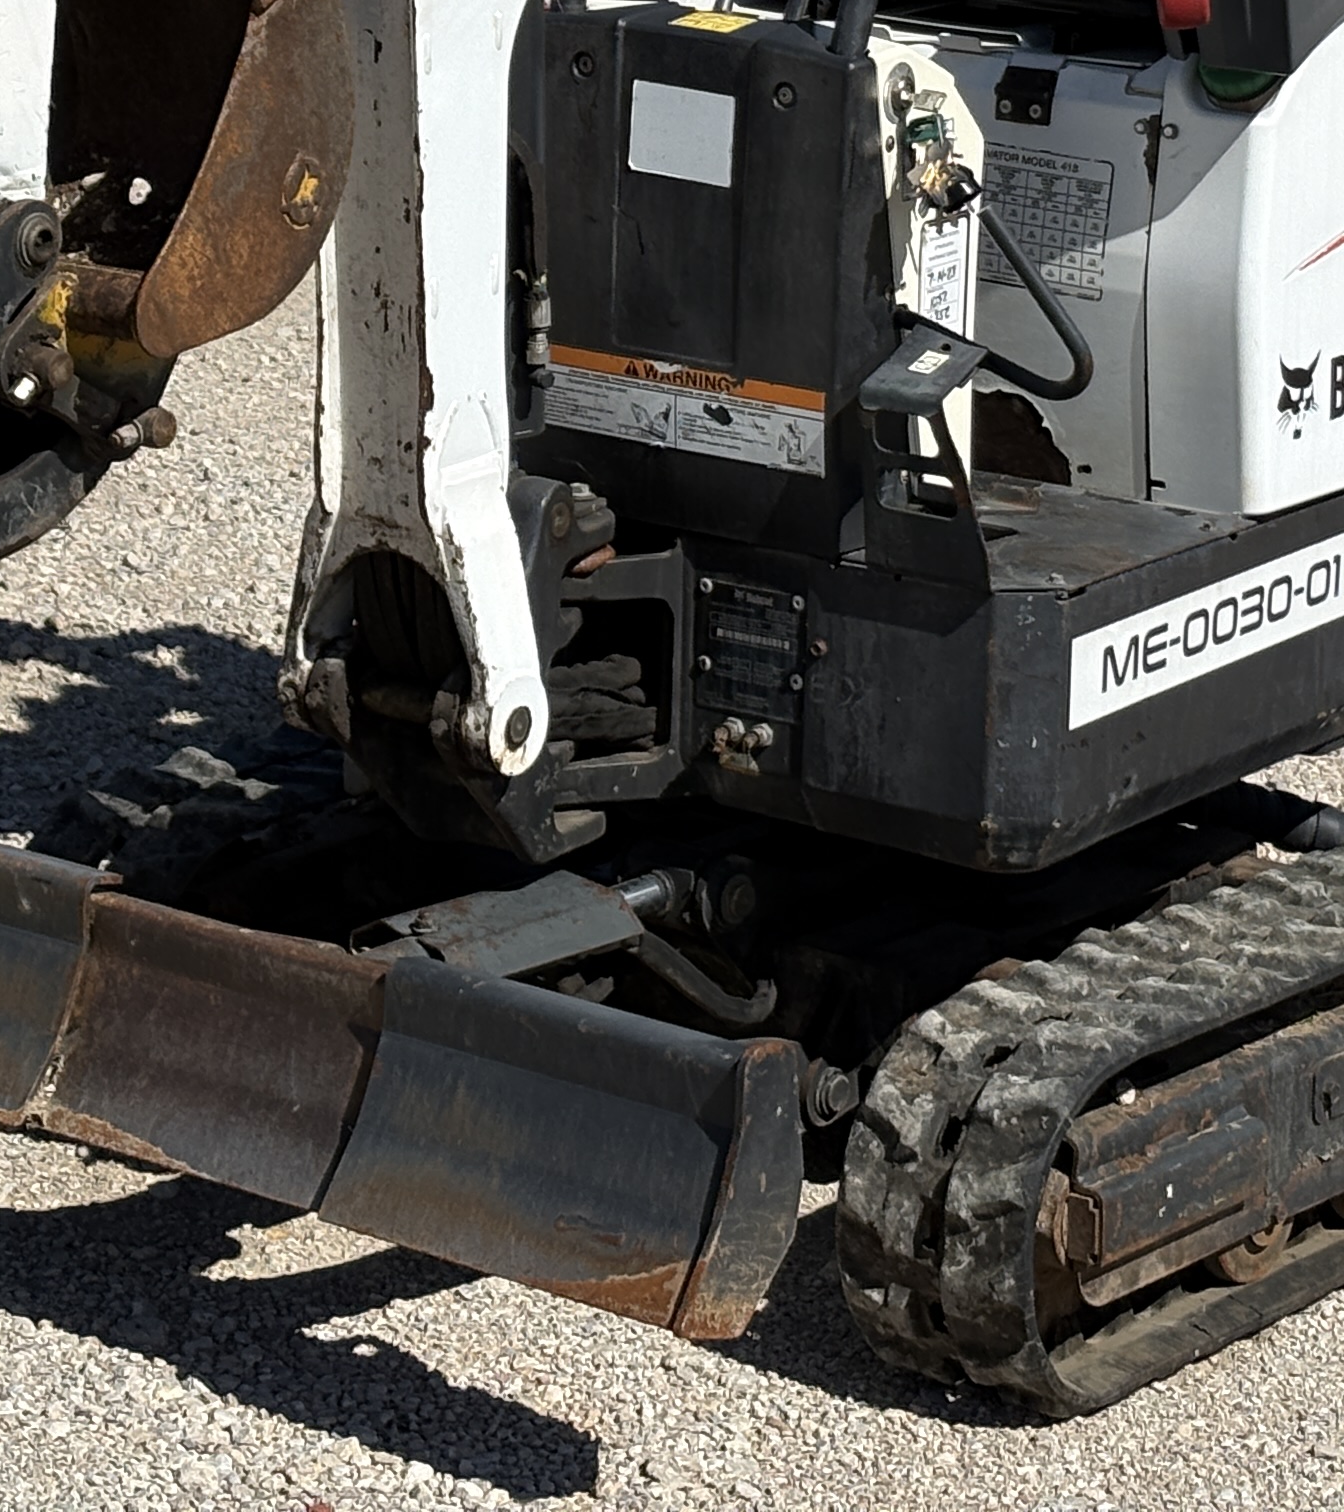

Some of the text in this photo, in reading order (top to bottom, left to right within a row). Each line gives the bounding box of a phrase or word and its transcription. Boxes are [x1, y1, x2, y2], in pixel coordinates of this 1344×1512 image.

[1021, 155, 1058, 171] MODEL
[642, 361, 733, 394] WARNING
[1100, 553, 1342, 694] ME-0030-01
